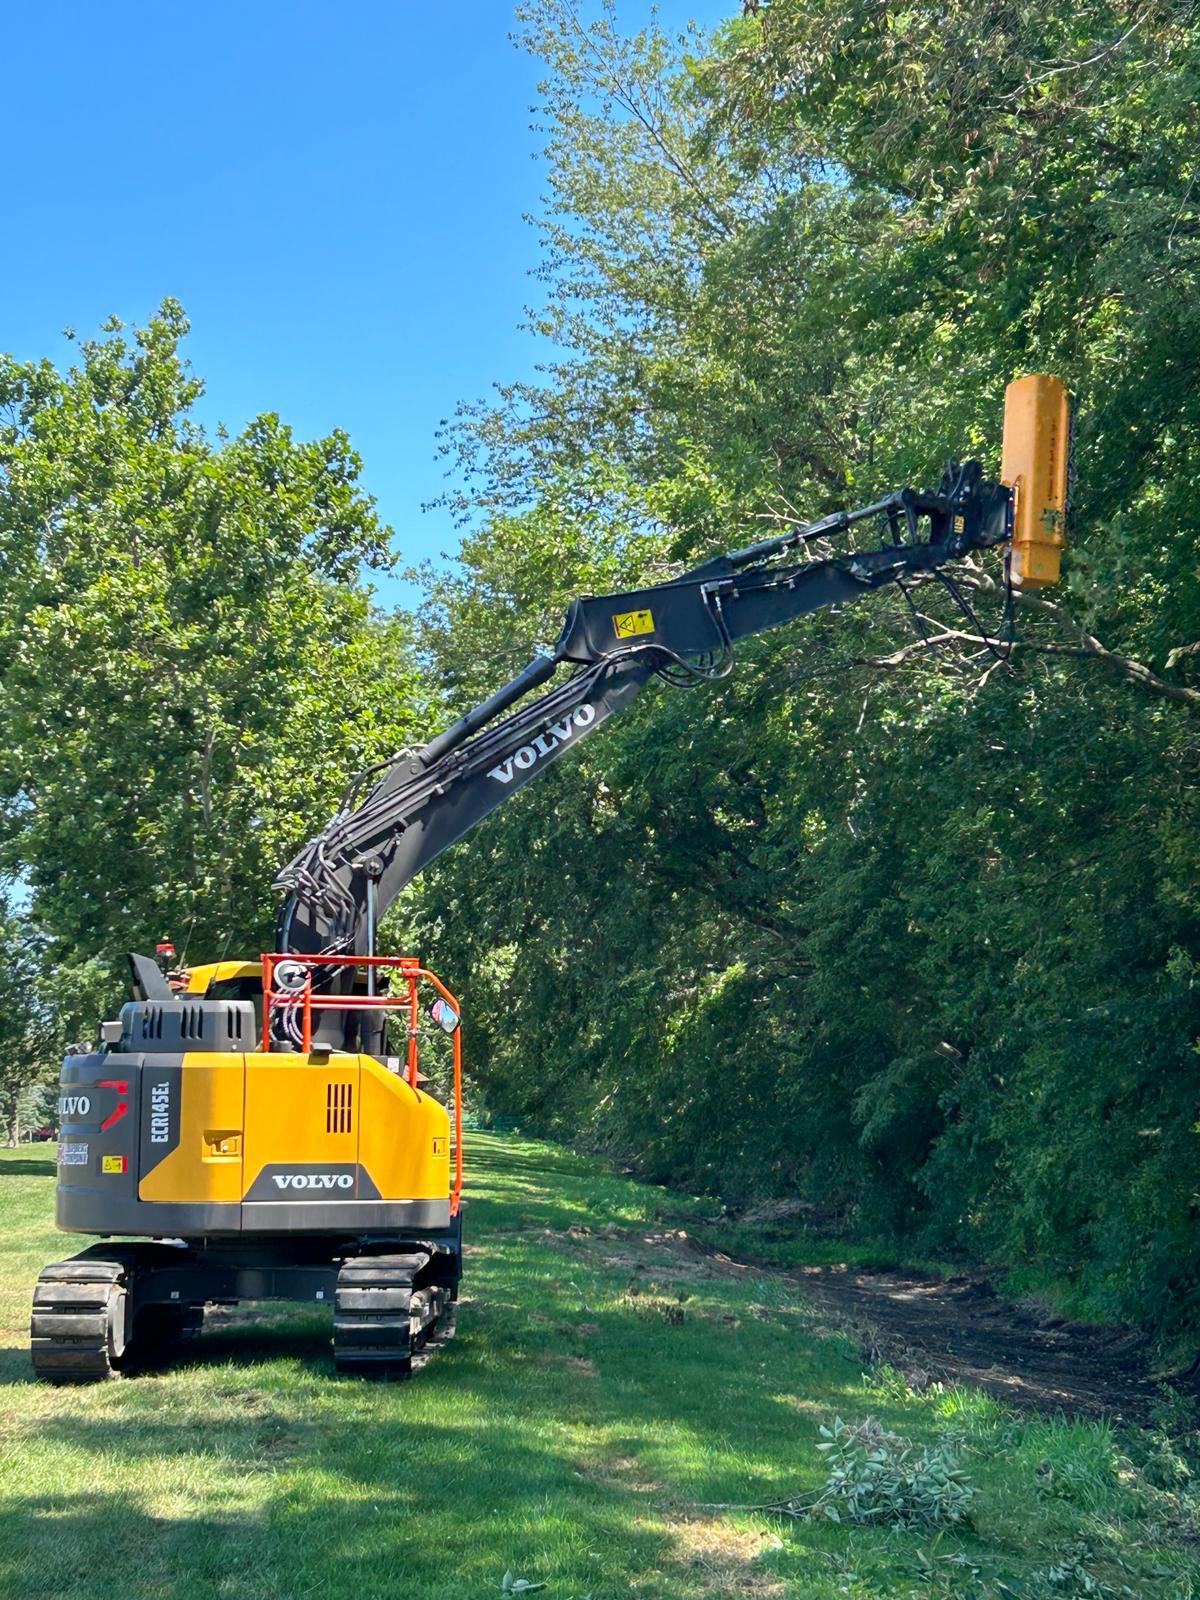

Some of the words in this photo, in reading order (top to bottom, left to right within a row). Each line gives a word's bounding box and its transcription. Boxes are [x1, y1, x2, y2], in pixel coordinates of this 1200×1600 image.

[487, 703, 596, 784] VOLVO
[59, 1096, 90, 1115] LVO
[272, 1174, 354, 1189] VOLVO
